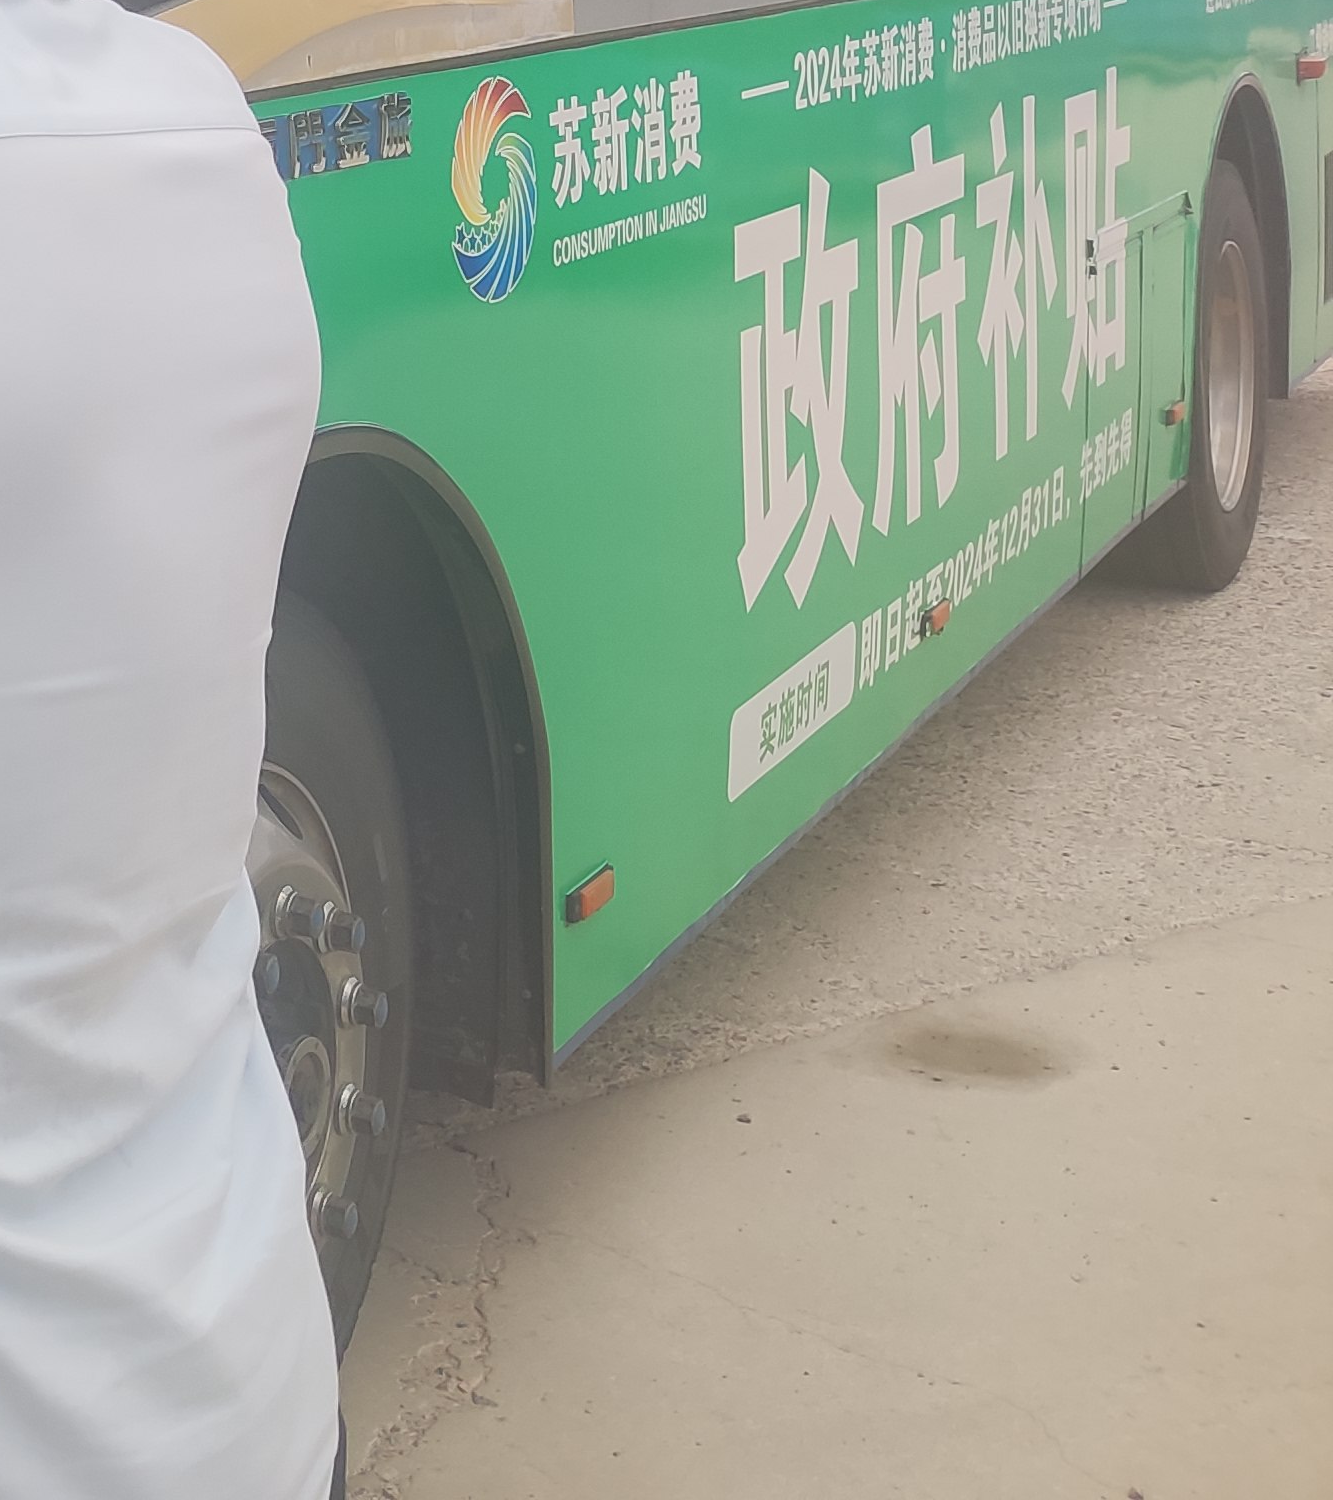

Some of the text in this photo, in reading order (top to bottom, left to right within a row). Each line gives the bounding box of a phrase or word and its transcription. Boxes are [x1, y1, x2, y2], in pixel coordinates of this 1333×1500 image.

[549, 69, 702, 209] 苏新消费
[552, 194, 708, 268] CONSUMPTION IN JIANGSU
[734, 66, 1131, 614] 政府补贴
[759, 659, 830, 764] 实施时间
